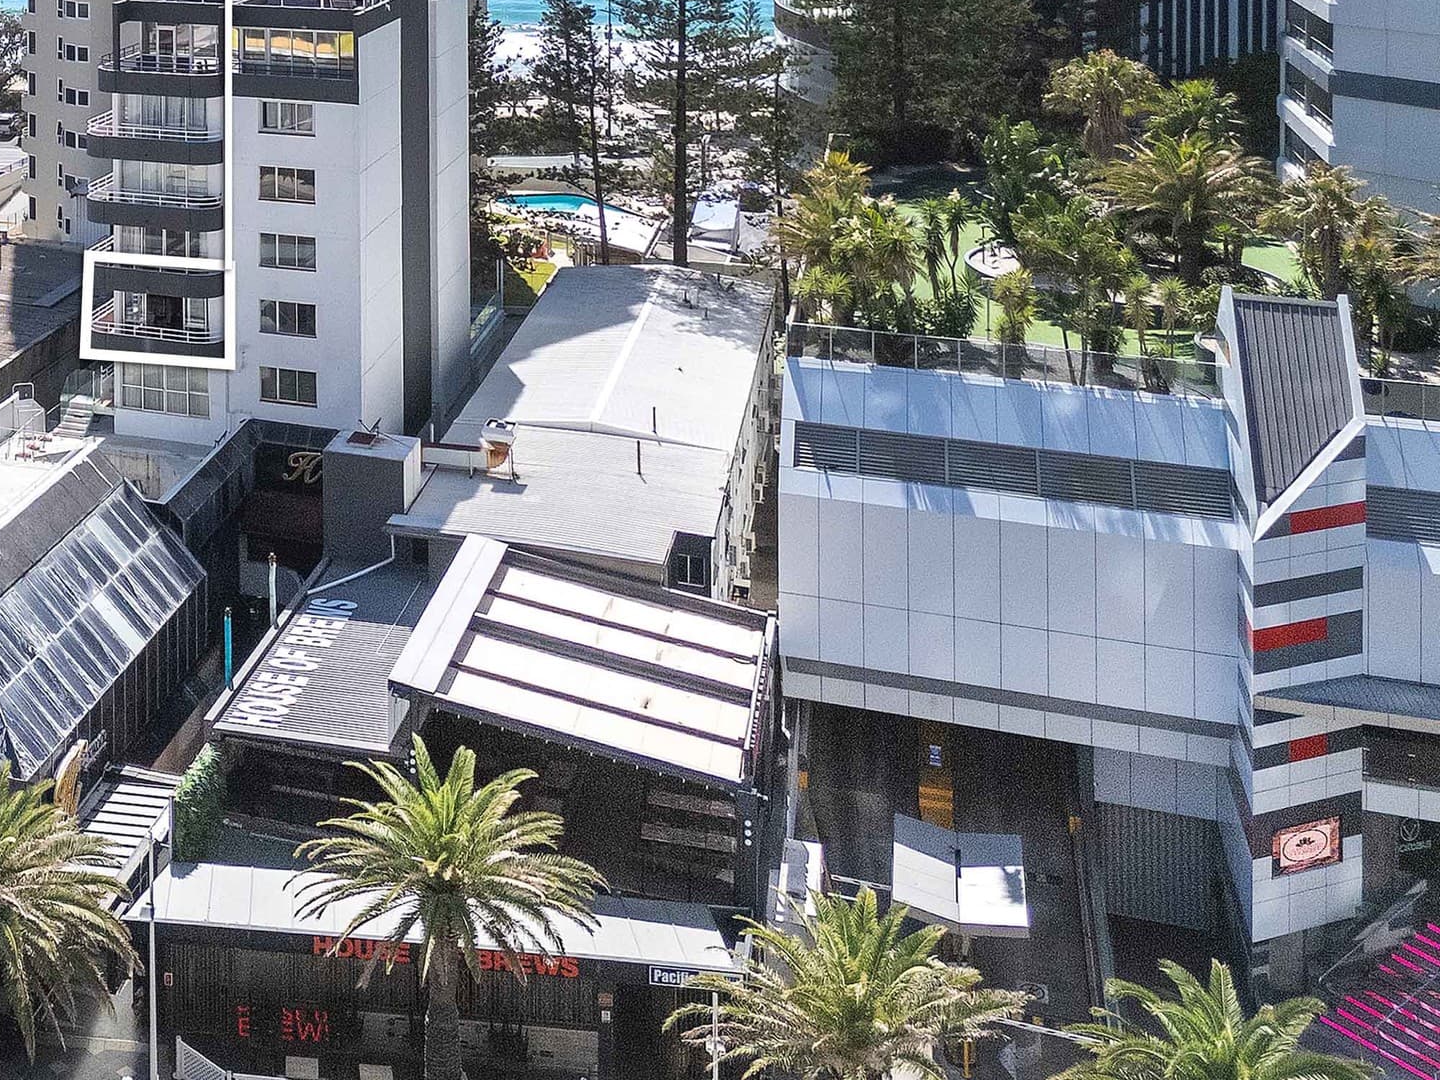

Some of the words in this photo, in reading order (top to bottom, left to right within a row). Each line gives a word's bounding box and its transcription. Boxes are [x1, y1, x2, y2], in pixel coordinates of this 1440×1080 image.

[282, 598, 358, 648] BREWS
[267, 646, 323, 672] OF
[228, 671, 310, 727] HOUSE
